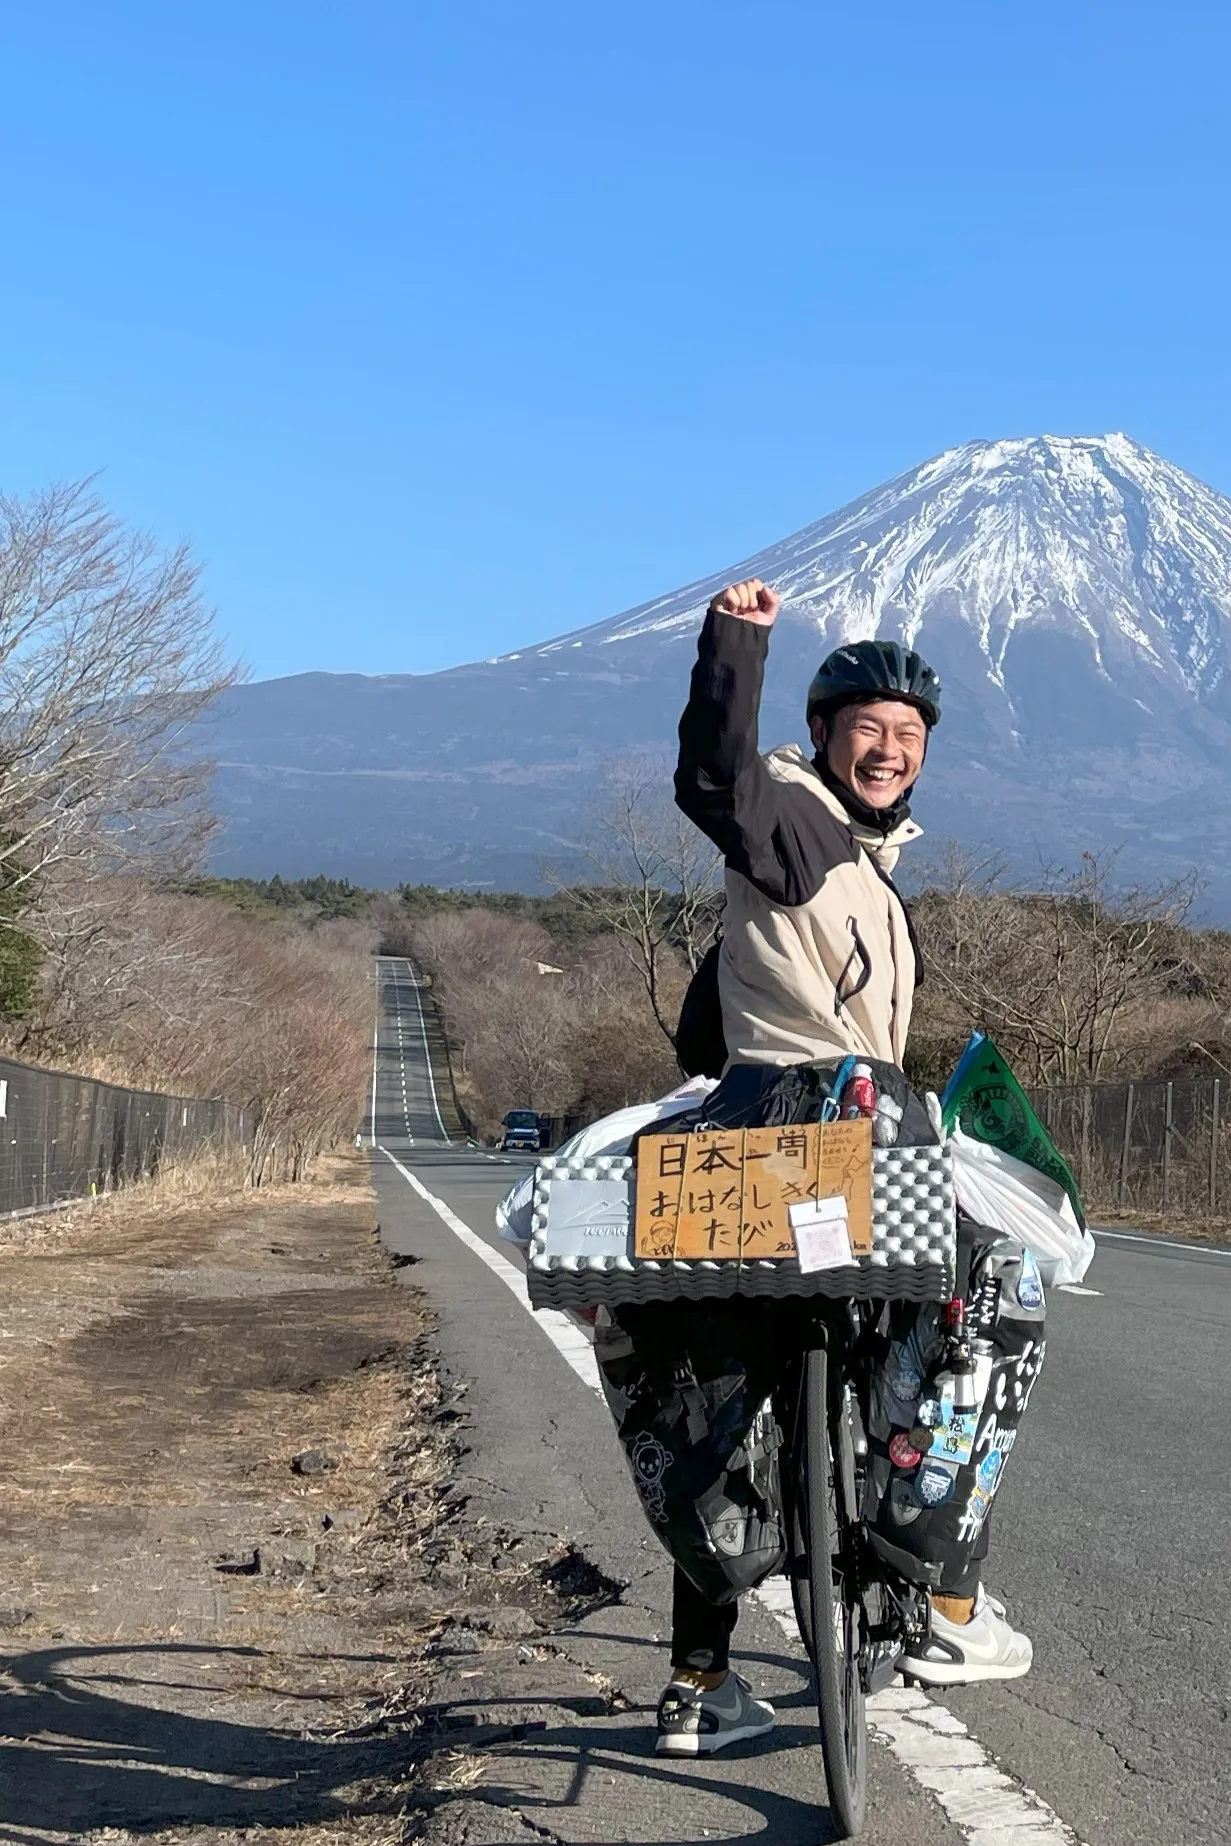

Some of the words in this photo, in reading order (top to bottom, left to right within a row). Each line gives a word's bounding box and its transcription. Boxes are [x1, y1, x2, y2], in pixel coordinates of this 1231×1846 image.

[659, 1134, 808, 1178] 日本一周
[703, 1218, 774, 1251] たび
[775, 1241, 798, 1252] 202
